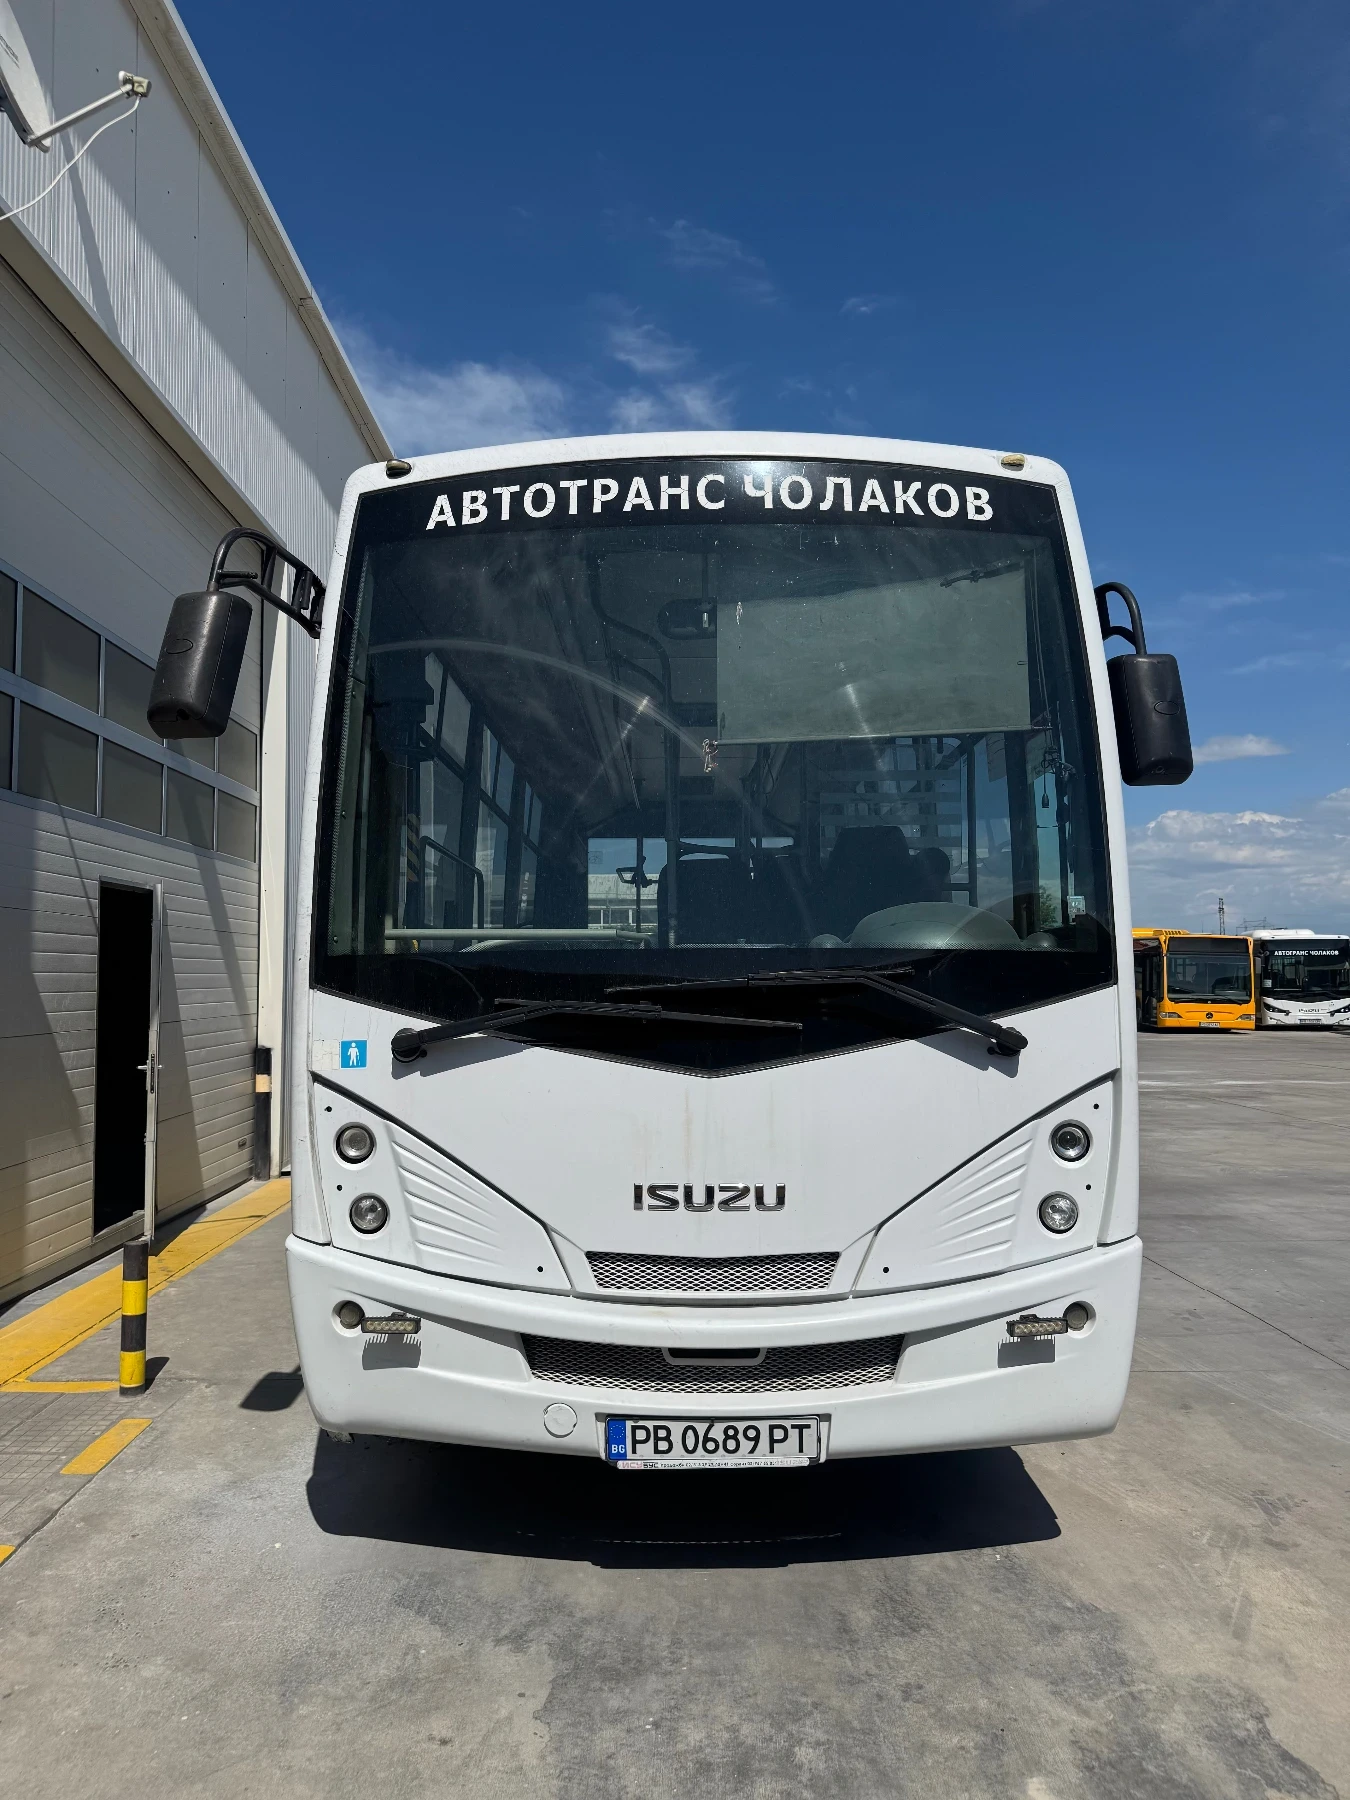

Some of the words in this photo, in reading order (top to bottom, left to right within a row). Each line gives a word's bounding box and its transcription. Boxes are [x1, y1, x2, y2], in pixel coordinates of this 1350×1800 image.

[425, 473, 726, 531] АВТОТРАНС
[742, 474, 994, 522] ЧОЛАКОВ
[633, 1182, 786, 1212] ISUZU
[611, 1444, 626, 1454] BG
[630, 1424, 674, 1455] PB
[681, 1423, 761, 1455] 0689
[768, 1423, 812, 1454] PT
